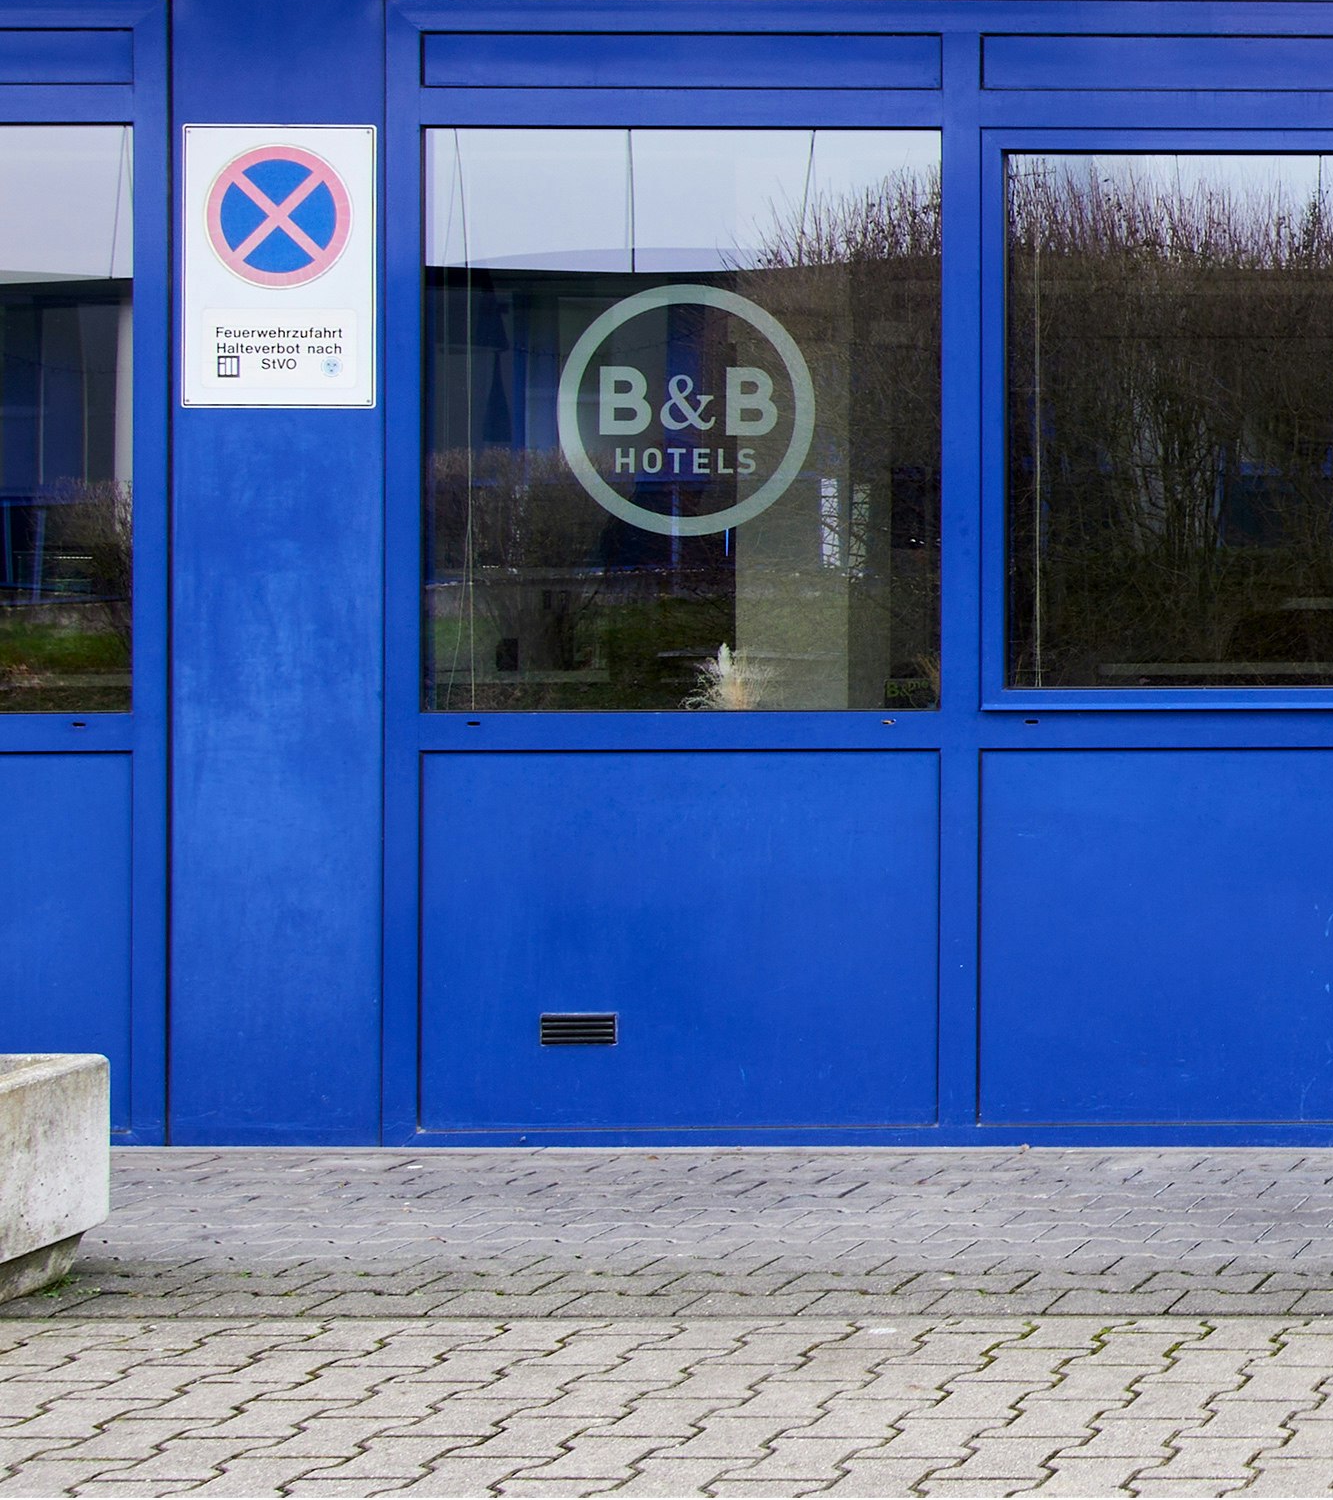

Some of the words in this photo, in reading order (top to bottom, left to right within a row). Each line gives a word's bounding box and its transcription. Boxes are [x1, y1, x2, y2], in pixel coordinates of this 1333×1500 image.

[215, 326, 343, 339] Feuerwehrzufahrt
[216, 342, 300, 355] Halteverbot
[307, 342, 343, 355] nach
[261, 358, 297, 370] StVO
[599, 365, 778, 436] B&B
[615, 447, 757, 474] HOTELS
